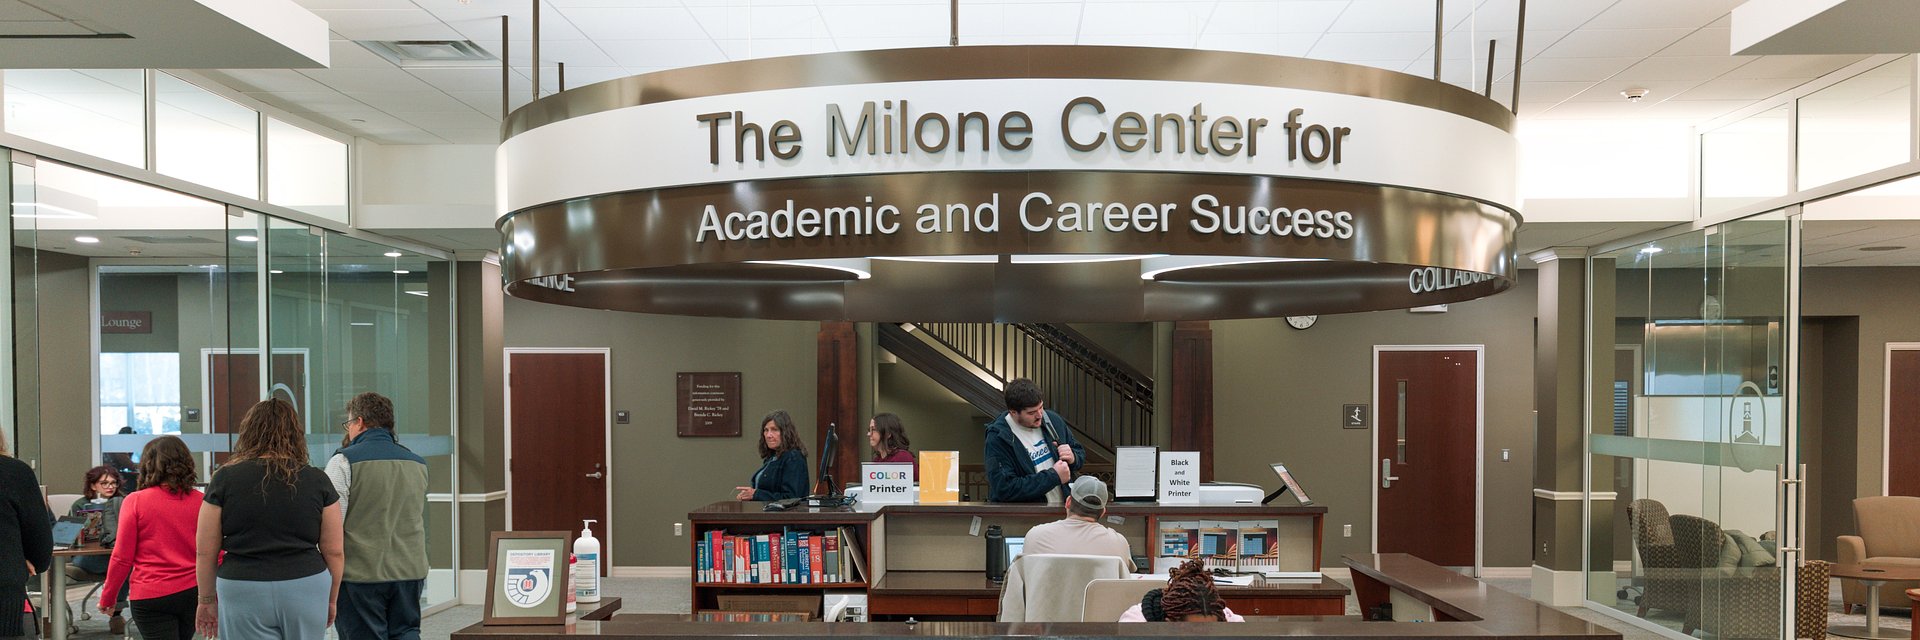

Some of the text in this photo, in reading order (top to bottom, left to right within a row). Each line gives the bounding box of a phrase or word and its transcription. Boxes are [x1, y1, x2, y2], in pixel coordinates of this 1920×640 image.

[696, 96, 1351, 165] The Milone Center for
[696, 191, 1354, 243] Academic and Career Success
[101, 315, 143, 330] Lounge
[869, 471, 906, 480] COLOR
[869, 484, 907, 493] Printer
